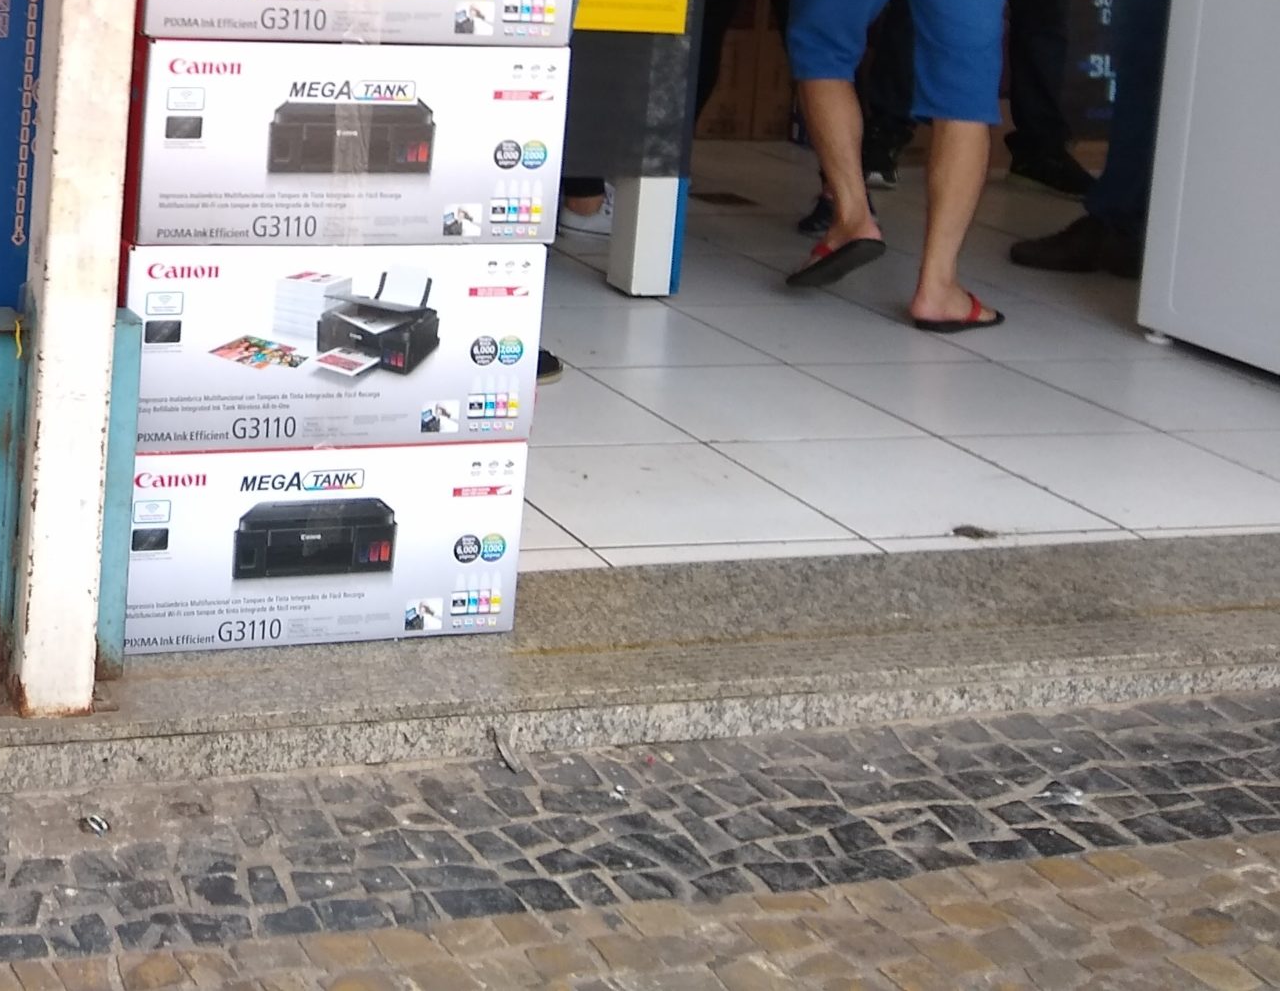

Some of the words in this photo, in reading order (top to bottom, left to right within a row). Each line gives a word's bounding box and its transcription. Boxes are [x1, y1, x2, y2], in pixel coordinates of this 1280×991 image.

[164, 17, 199, 28] PIXMA
[201, 18, 215, 28] Ink
[217, 17, 258, 29] Efficient
[261, 7, 327, 31] G3110
[168, 58, 242, 75] Canon
[289, 81, 352, 100] MEGA
[362, 84, 409, 97] TANK
[157, 229, 192, 238] PIXMA
[194, 228, 207, 238] Ink
[209, 227, 250, 238] Efficient
[253, 215, 317, 238] G3110
[147, 262, 220, 280] Canon
[138, 431, 172, 442] PIXMA
[174, 430, 187, 441] Ink
[190, 429, 230, 440] Efficient
[232, 416, 297, 439] G3110
[135, 472, 207, 488] Canon
[240, 472, 302, 492] MEGA
[312, 472, 358, 487] TANK
[124, 637, 158, 647] PIXMA
[160, 636, 173, 645] Ink
[176, 634, 215, 644] Efficient
[218, 619, 282, 642] G3110
